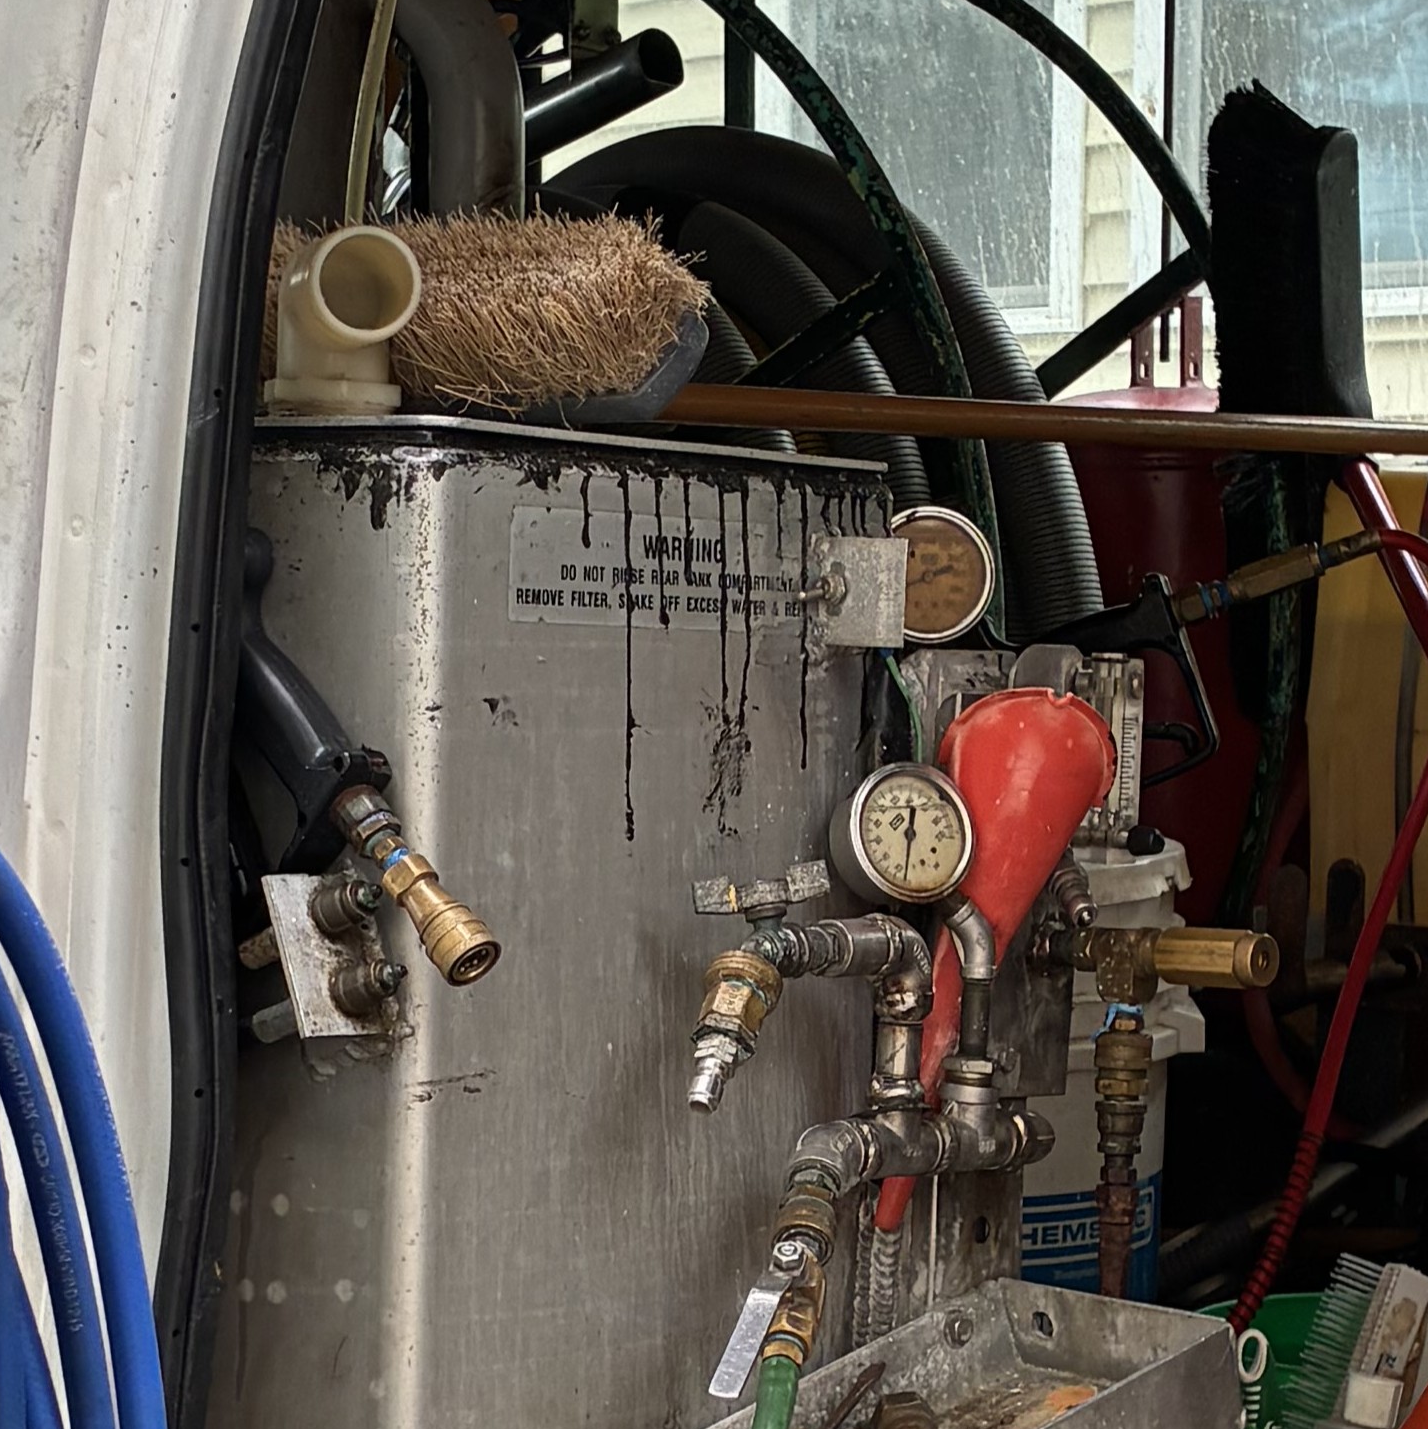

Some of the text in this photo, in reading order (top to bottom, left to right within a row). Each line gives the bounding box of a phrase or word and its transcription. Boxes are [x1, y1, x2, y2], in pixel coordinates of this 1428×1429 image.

[560, 564, 577, 581] DO
[583, 566, 606, 582] NOT
[612, 567, 645, 585] RISE
[651, 569, 680, 586] RAR
[684, 571, 712, 588] ANK
[516, 588, 565, 606] REMOVE
[618, 593, 654, 611] SAKE
[686, 596, 727, 614] EXCES
